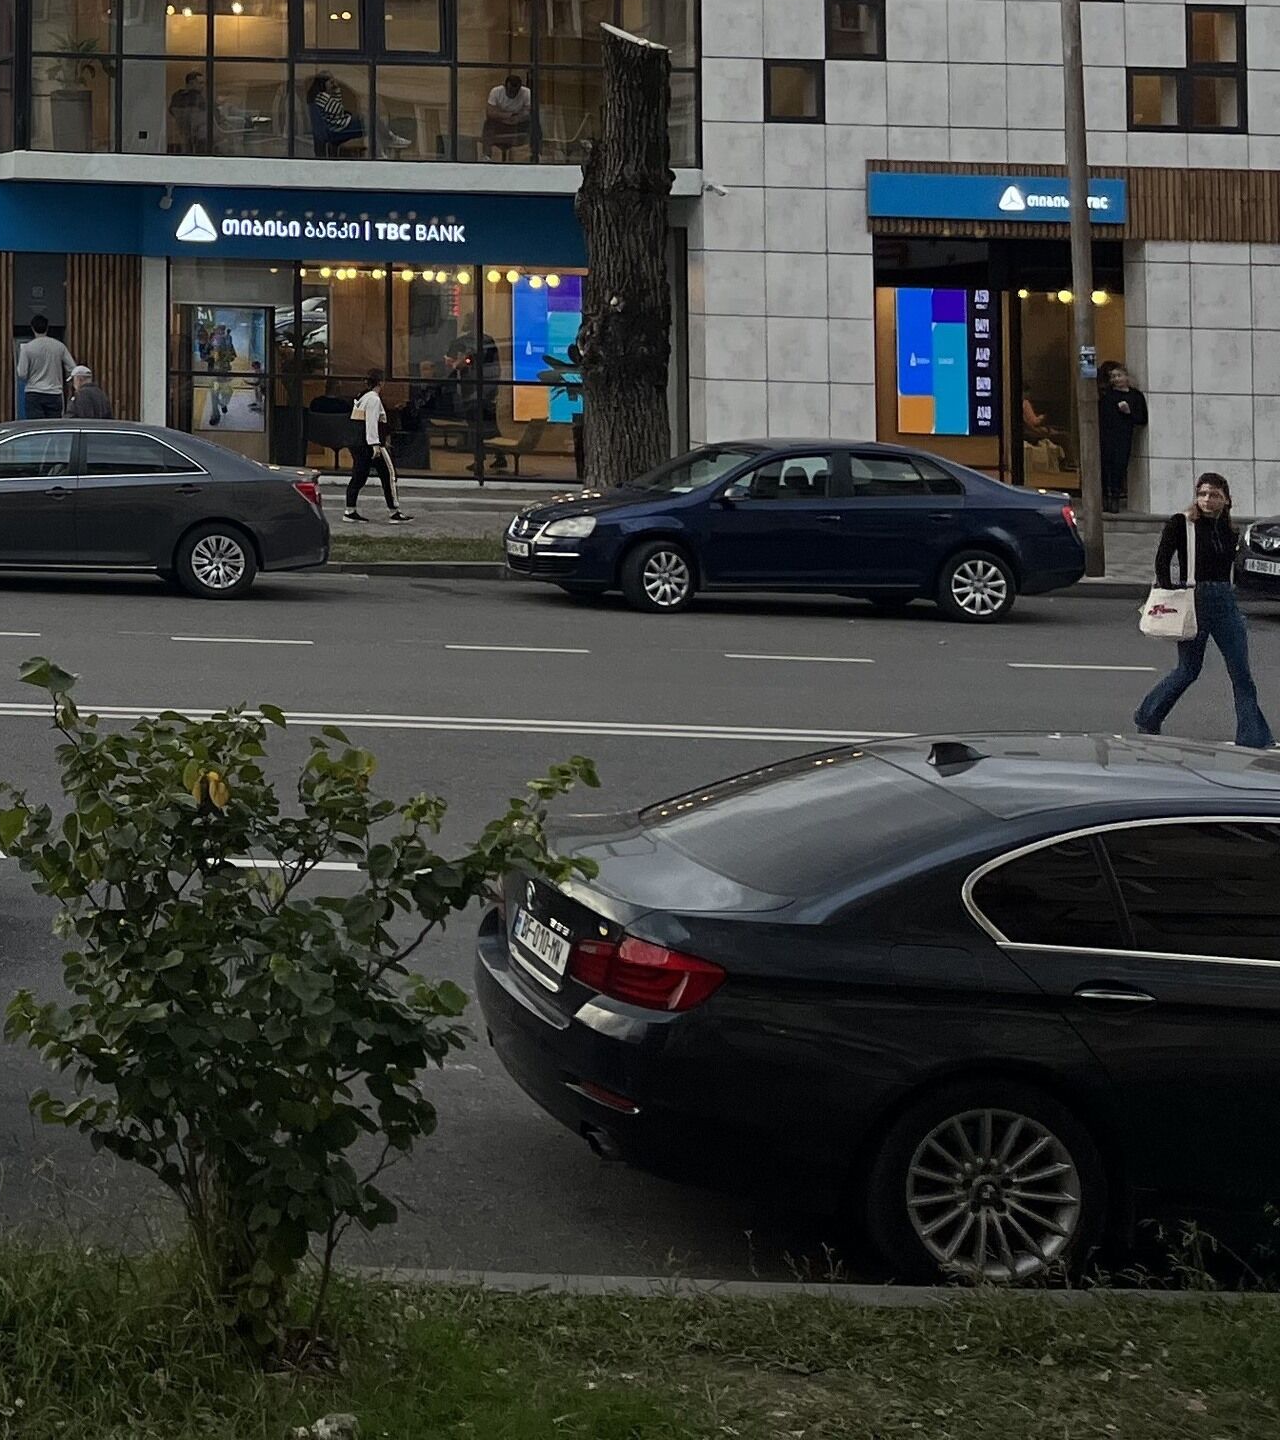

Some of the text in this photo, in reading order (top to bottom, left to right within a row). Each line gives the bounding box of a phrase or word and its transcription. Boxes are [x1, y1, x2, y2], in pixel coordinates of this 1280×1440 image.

[221, 217, 360, 239] თიბისი ბანკი
[375, 222, 466, 243] TBC BANK
